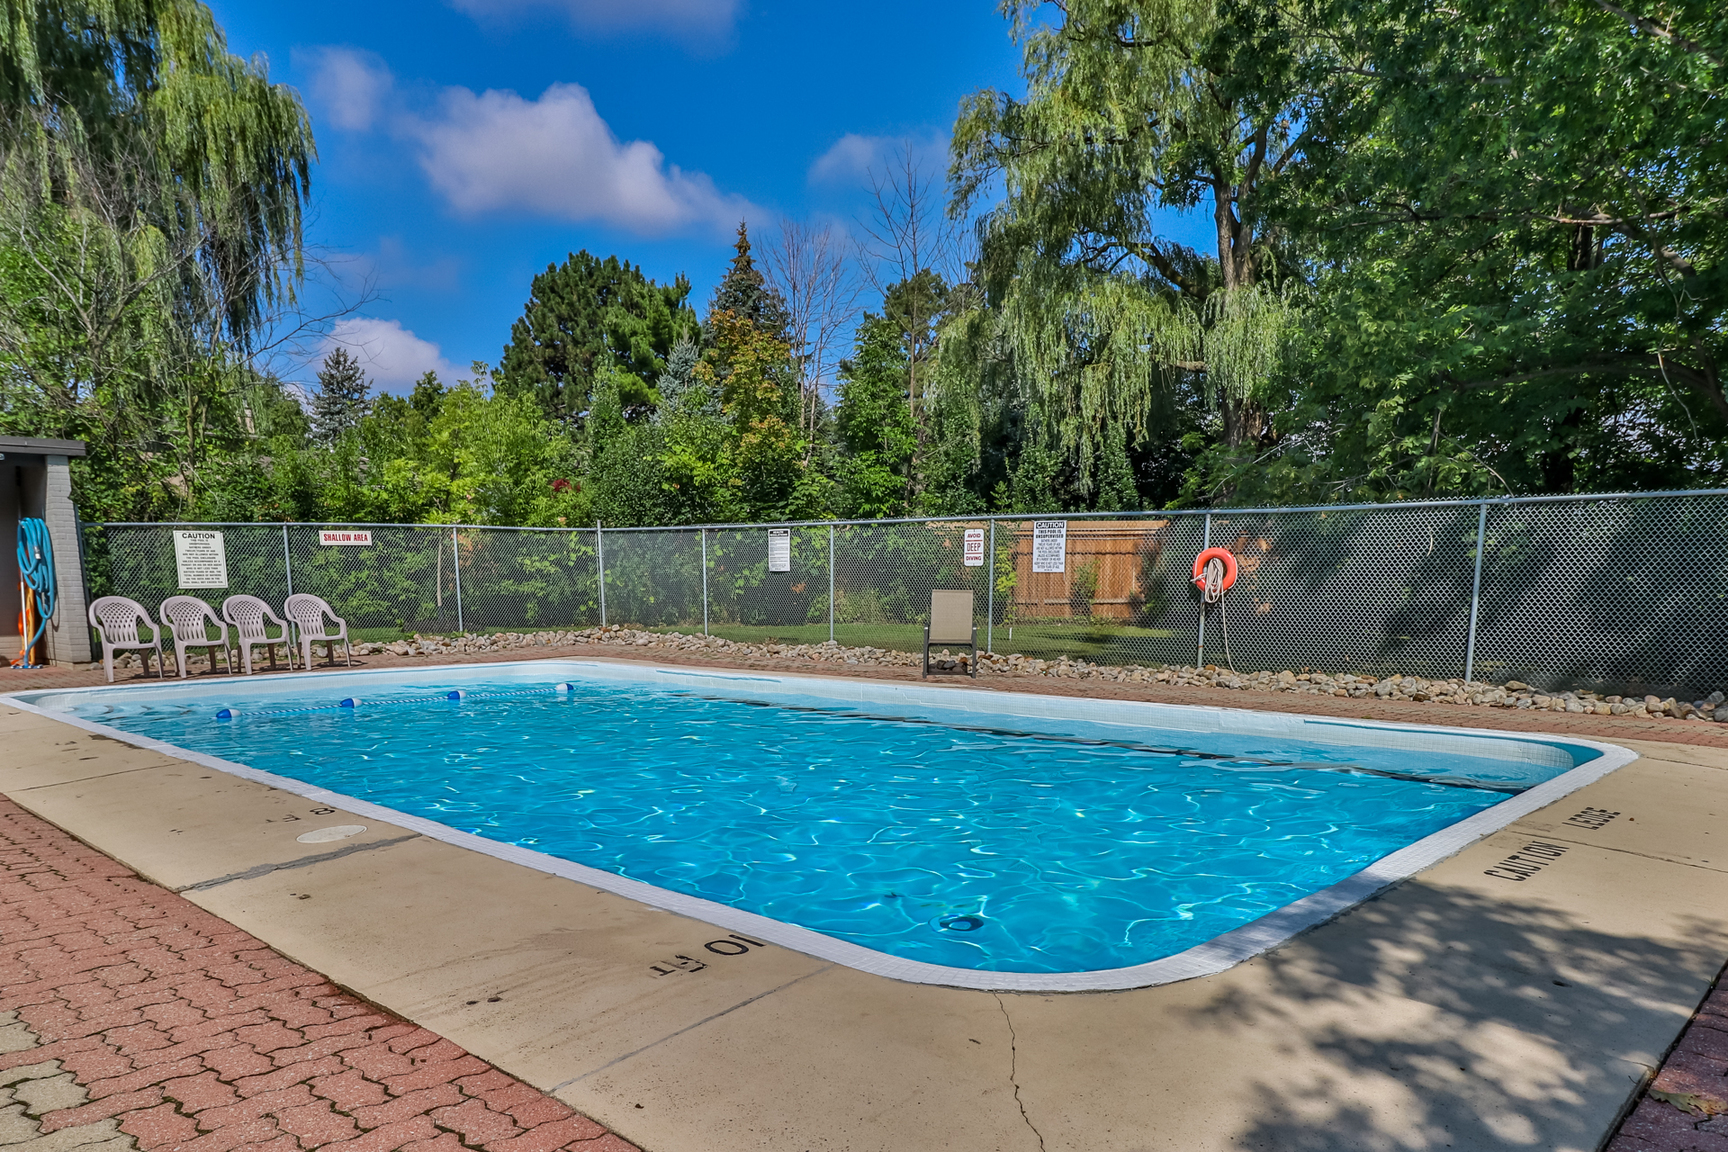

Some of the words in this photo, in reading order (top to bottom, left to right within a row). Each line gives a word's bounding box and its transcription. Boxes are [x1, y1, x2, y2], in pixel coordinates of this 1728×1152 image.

[324, 533, 351, 541] SHALLOW
[354, 533, 368, 541] AREA
[967, 543, 981, 551] DEEP
[1484, 841, 1570, 881] CAUTION
[1562, 807, 1621, 830] LEDGE
[704, 934, 767, 956] 10
